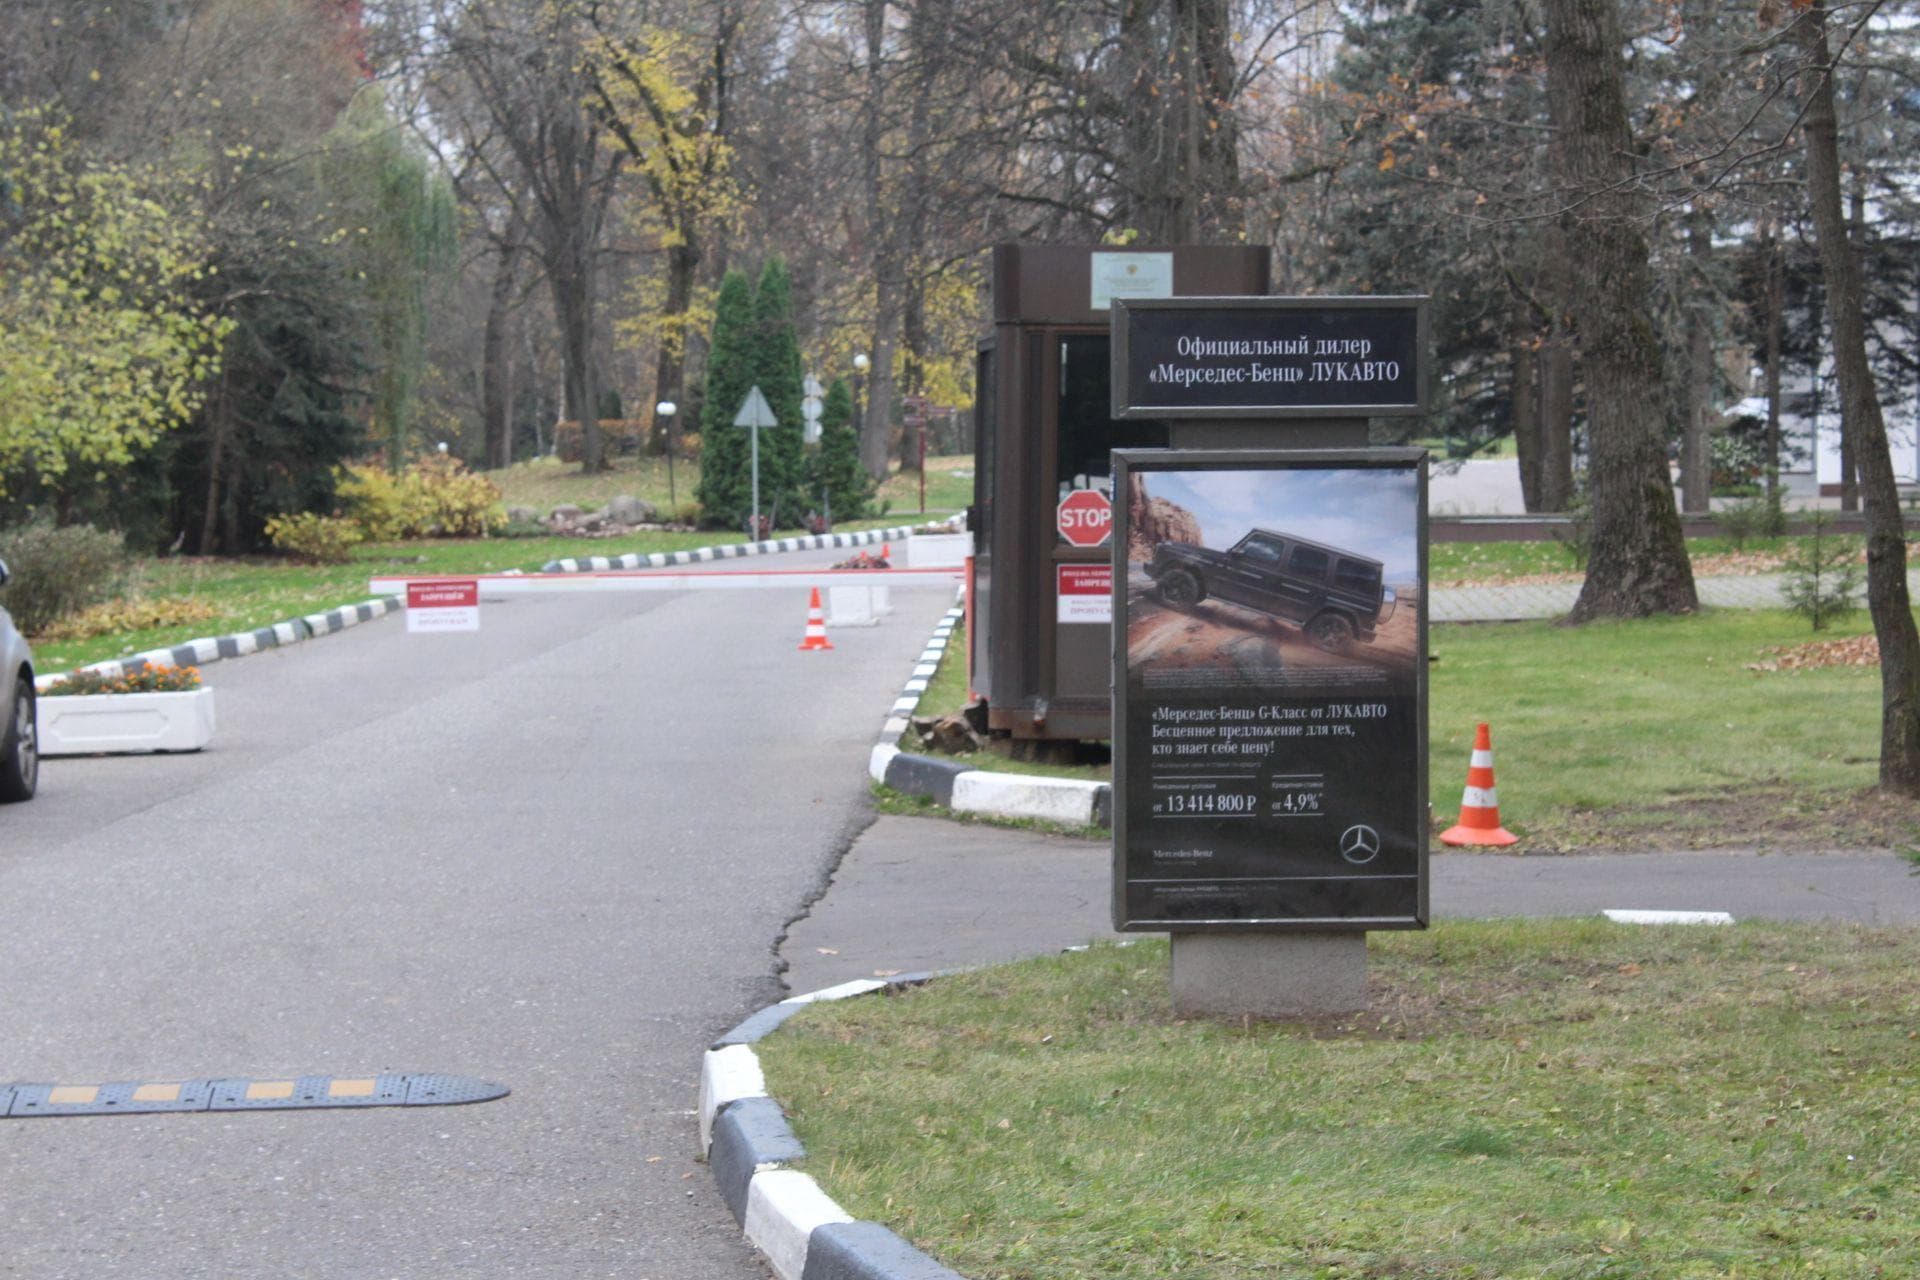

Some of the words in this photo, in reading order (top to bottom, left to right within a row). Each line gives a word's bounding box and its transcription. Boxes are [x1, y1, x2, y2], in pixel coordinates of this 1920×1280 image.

[1177, 335, 1309, 361] Официальный
[1314, 336, 1371, 359] дилер
[1149, 362, 1304, 388] «Мерседес-Бенц»
[1308, 361, 1400, 382] ЛУКАВТО
[1060, 508, 1112, 527] STOP
[1152, 706, 1255, 722] «Мерседес-Бенц»
[1258, 705, 1306, 720] G-Класс
[1310, 708, 1323, 718] от
[1326, 704, 1387, 718] ЛУКАВТО
[1152, 724, 1216, 738] Бесценное
[1219, 725, 1303, 741] предложение
[1306, 725, 1329, 736] для
[1332, 725, 1356, 737] тех,
[1152, 744, 1172, 755] кто
[1175, 743, 1208, 755] знает
[1211, 741, 1238, 754] себе
[1241, 740, 1275, 757] цену!
[1168, 795, 1184, 811] 13
[1188, 795, 1214, 811] 414
[1217, 795, 1244, 811] 800
